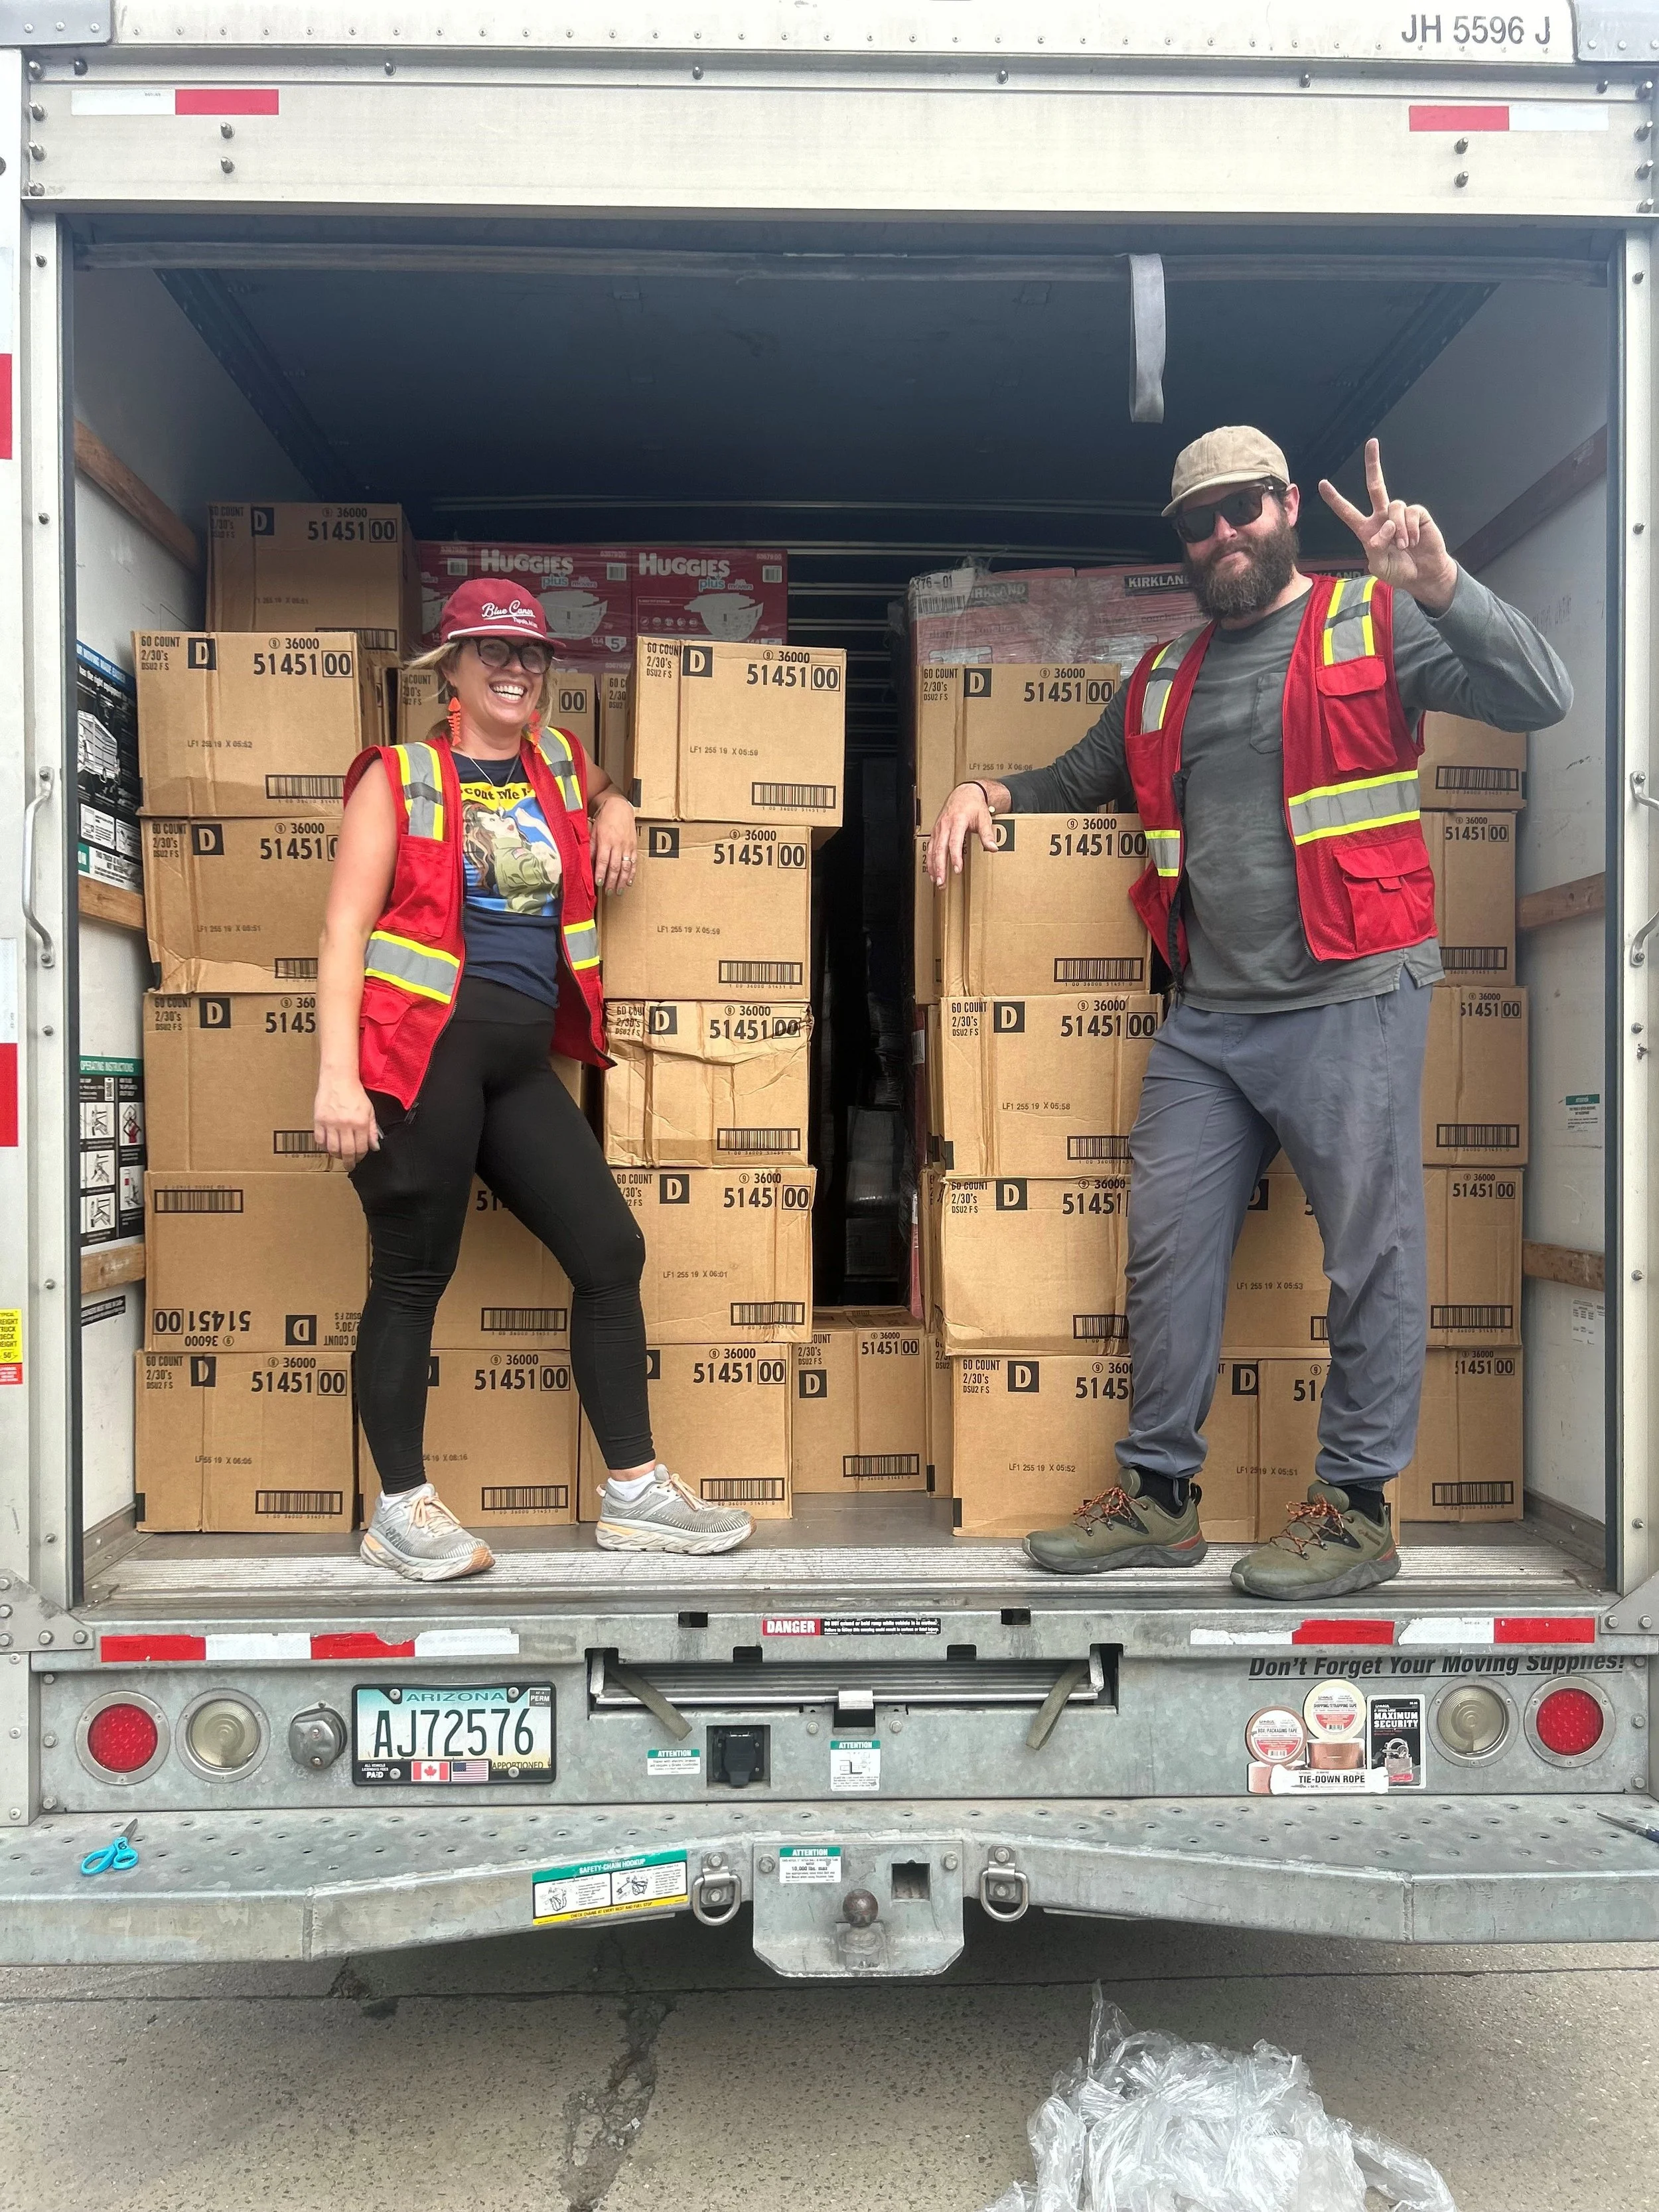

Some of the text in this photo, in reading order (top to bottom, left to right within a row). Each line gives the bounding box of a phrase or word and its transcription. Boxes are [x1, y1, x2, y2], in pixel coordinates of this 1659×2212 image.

[1402, 15, 1550, 44] JH 5596 J
[337, 508, 367, 518] 36000
[308, 521, 364, 540] 51451
[480, 548, 573, 575] HUGGIES
[638, 552, 730, 577] HUGGIES
[541, 574, 569, 589] plus
[699, 577, 725, 592] plus
[482, 603, 507, 617] Blue
[155, 636, 180, 647] COUNT
[285, 638, 319, 649] 36000
[611, 638, 619, 649] 5
[196, 642, 208, 664] D
[777, 651, 810, 664] 36000
[253, 653, 350, 675] 51451 00
[647, 656, 672, 668] 2/30's
[690, 650, 705, 672] D
[747, 664, 837, 688] 51451 00
[924, 668, 958, 678] 60 COUNT
[1054, 668, 1085, 678] 36000
[924, 682, 947, 692] 2/30's
[970, 672, 984, 693] D
[1024, 682, 1113, 702] 51451 00
[561, 692, 584, 711] 00
[460, 788, 494, 800] cout
[497, 788, 520, 799] Me
[163, 823, 186, 834] COUNT
[291, 823, 325, 834] 36000
[1083, 818, 1117, 830] 36000
[199, 829, 215, 850] D
[745, 830, 776, 841] 36000
[1445, 826, 1506, 840] 51451 00
[260, 838, 322, 859] 51451
[656, 832, 672, 853] D
[1050, 834, 1112, 856] 51451
[713, 844, 804, 866] 51451 00
[166, 997, 192, 1009] COUNT
[952, 1001, 987, 1013] 60 COUNT
[1094, 999, 1125, 1011] 36000
[1503, 1003, 1520, 1017] 00
[207, 1002, 223, 1023] D
[740, 1005, 770, 1016] 36000
[1001, 1006, 1017, 1028] D
[654, 1011, 668, 1030] D
[952, 1016, 977, 1027] 2/30's
[1061, 1015, 1155, 1037] 51451 00
[710, 1019, 768, 1042] 51451
[629, 1174, 652, 1184] COUNT
[1094, 1177, 1125, 1189] 36000
[668, 1179, 682, 1199] D
[1003, 1184, 1019, 1206] D
[1453, 1183, 1514, 1197] 51451 00
[784, 1188, 808, 1208] 00
[952, 1193, 977, 1205] 2/30's
[1062, 1193, 1123, 1215] 51451
[189, 1311, 251, 1331] 51451
[293, 1319, 309, 1341] D
[184, 1335, 218, 1347] 36000
[862, 1341, 918, 1355] 51451 00
[159, 1356, 183, 1366] COUNT
[506, 1355, 538, 1364] 36000
[724, 1349, 755, 1359] 36000
[283, 1358, 316, 1368] 36000
[964, 1359, 1000, 1370] 60 COUNT
[1496, 1360, 1512, 1373] 00
[147, 1370, 172, 1380] 2/30's
[474, 1368, 568, 1390] 51451 00
[693, 1362, 784, 1383] 51451 00
[964, 1373, 988, 1384] 2/30's
[1015, 1366, 1031, 1387] D
[252, 1371, 345, 1393] 51451 00
[806, 1374, 820, 1394] D
[767, 1621, 815, 1633] DANGER
[1249, 1655, 1624, 1678] Don't Forget Your Moving Supplies!
[406, 1692, 505, 1702] ARIZONA
[374, 1708, 534, 1758] AJ72576
[579, 1858, 646, 1874] SAFETY-CHAIN HOOKUP
